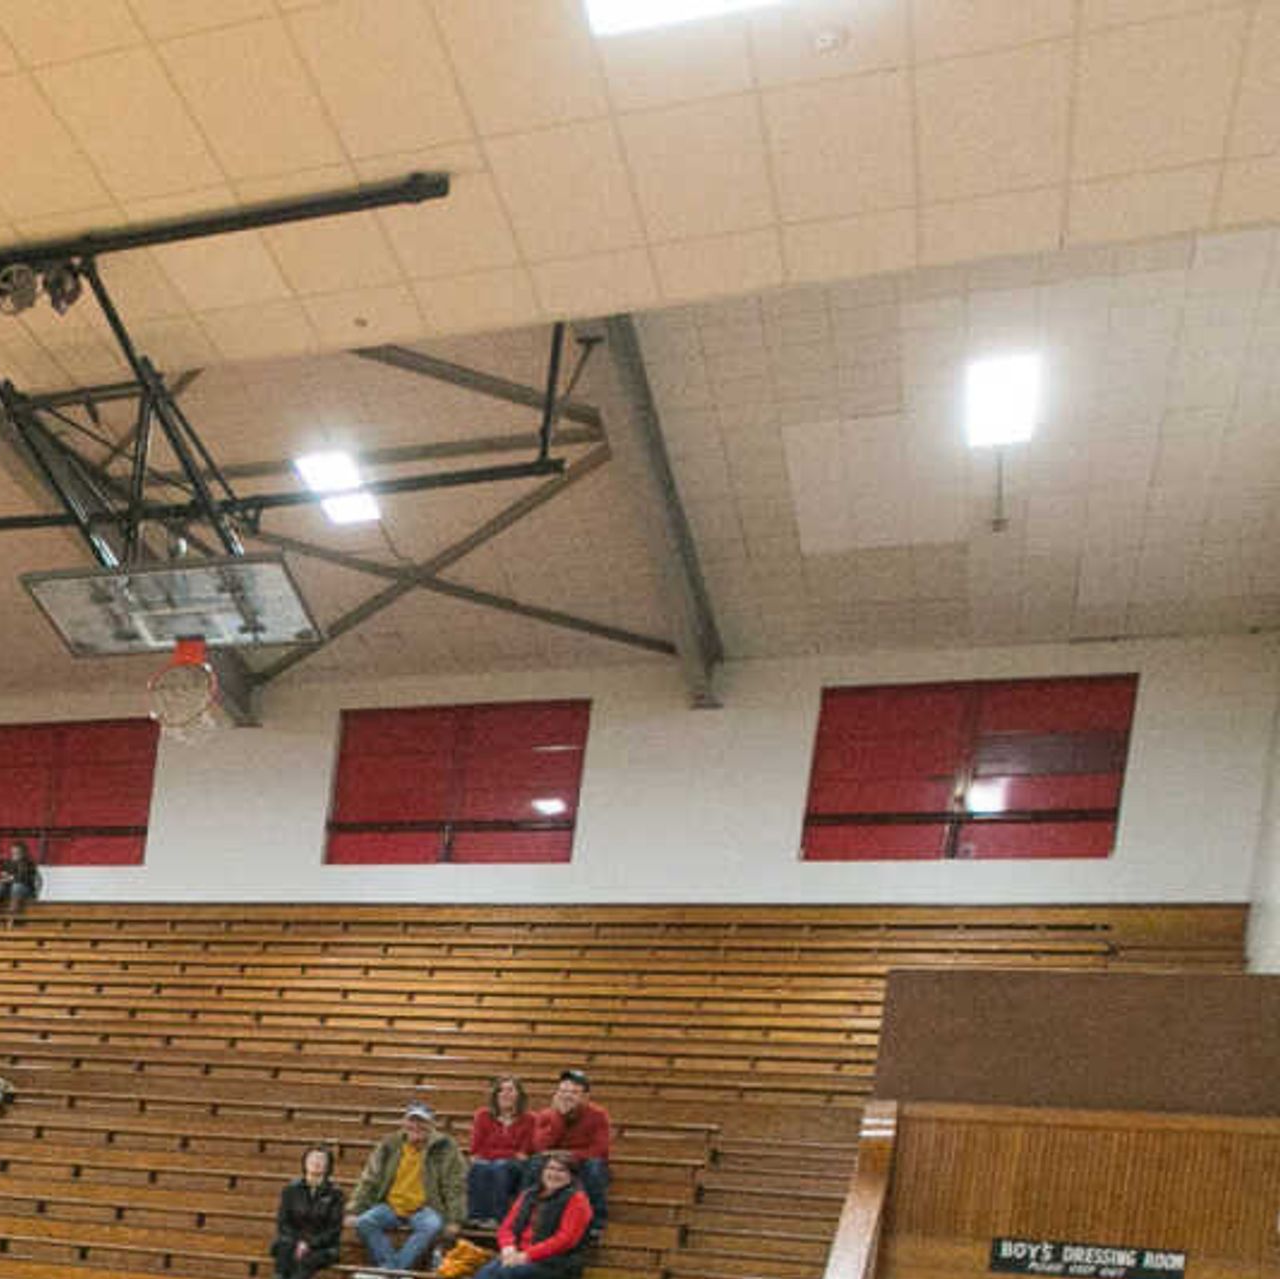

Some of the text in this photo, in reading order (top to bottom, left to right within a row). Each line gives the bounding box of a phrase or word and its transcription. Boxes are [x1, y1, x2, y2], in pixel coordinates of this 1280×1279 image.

[1000, 1240, 1186, 1271] BOY'S DRESSING ROOM
